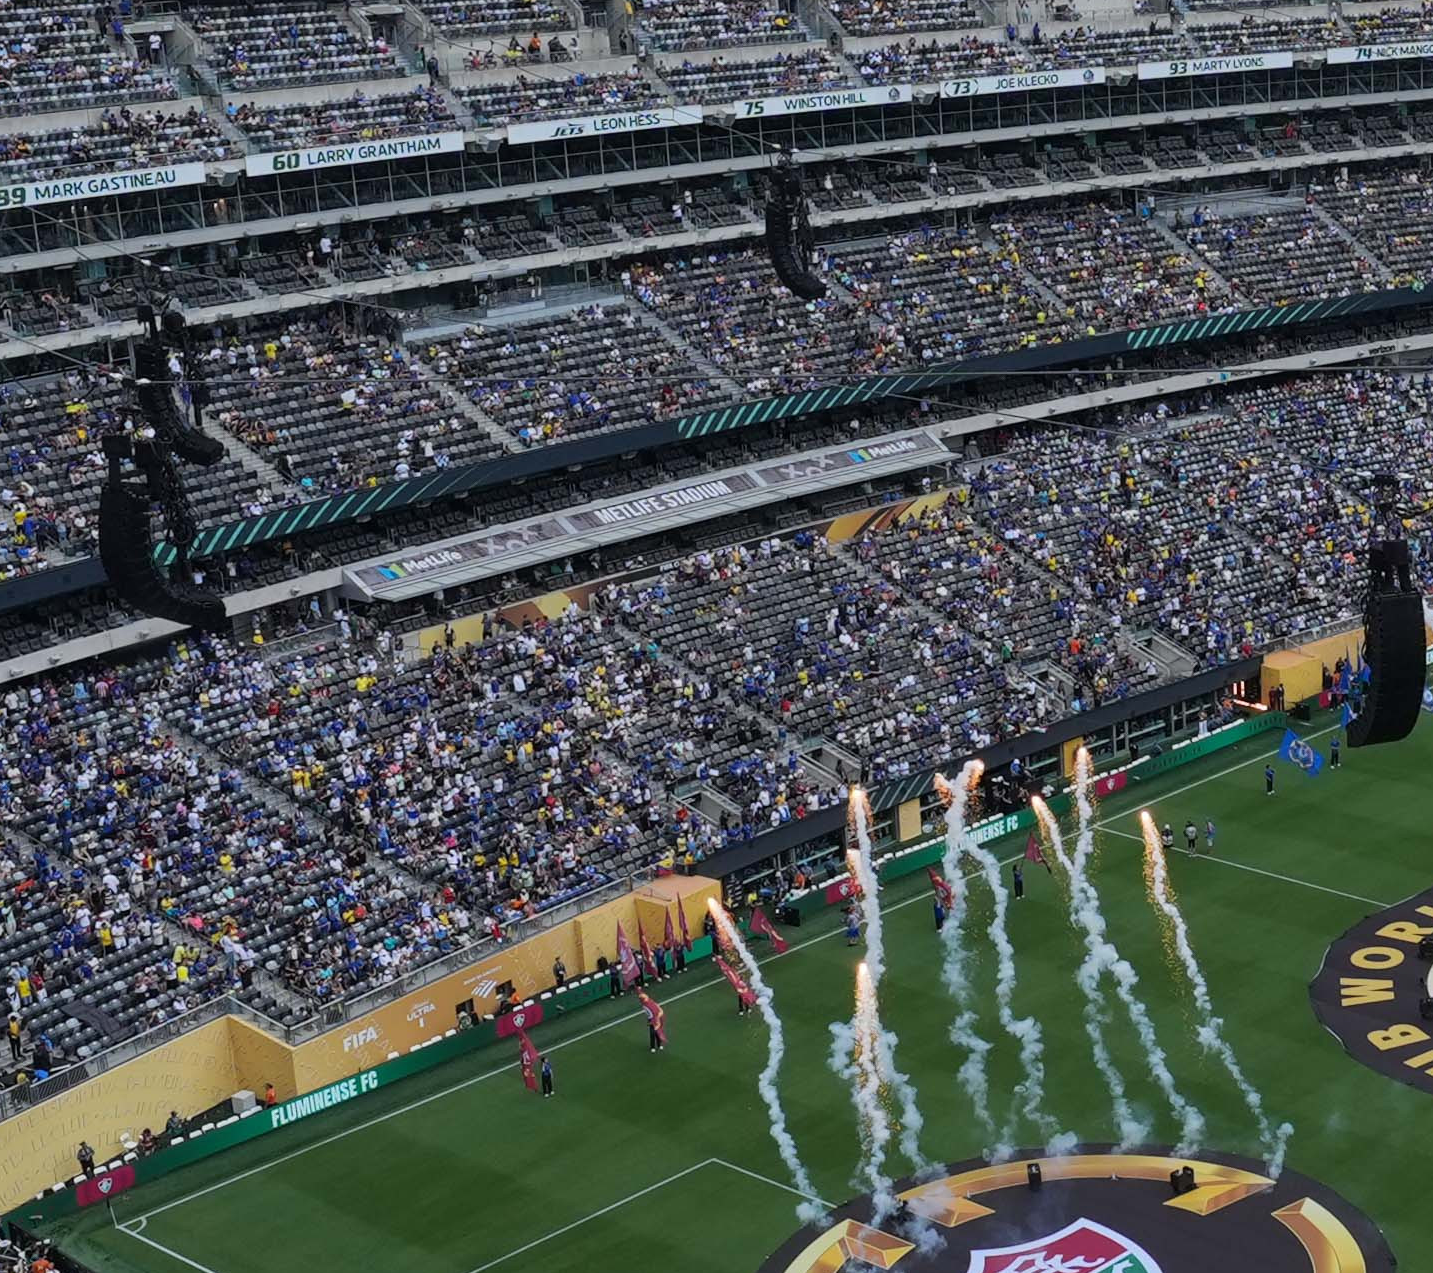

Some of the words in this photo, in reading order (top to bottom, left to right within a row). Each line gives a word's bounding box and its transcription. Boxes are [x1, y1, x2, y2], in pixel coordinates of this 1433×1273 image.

[1355, 47, 1372, 59] 74
[1169, 62, 1188, 74] 93
[1193, 60, 1230, 72] MARTY
[1232, 57, 1264, 69] LYONS
[995, 78, 1015, 90] JOE
[1017, 74, 1059, 87] KLECKO
[744, 101, 765, 116] 75
[784, 94, 841, 110] WINSTON
[842, 91, 867, 105] HILL
[550, 123, 584, 137] JETS
[593, 116, 627, 132] LEON
[629, 113, 661, 126] HESS
[273, 153, 300, 171] 60
[307, 147, 354, 166] LARRY
[358, 138, 441, 158] GRANTHAM
[34, 184, 84, 202] MARK
[88, 170, 176, 194] GASTINEAU
[1369, 345, 1396, 356] verizon
[868, 440, 917, 458] MetLife
[594, 496, 665, 525] METLIFE
[661, 480, 732, 508] STADIUM
[403, 551, 462, 572] MetLife
[1007, 814, 1019, 833] FC
[407, 1003, 436, 1022] ULTRA
[343, 1027, 378, 1052] FIFA
[271, 1079, 358, 1128] FLUMINENSE
[359, 1070, 379, 1093] FC
